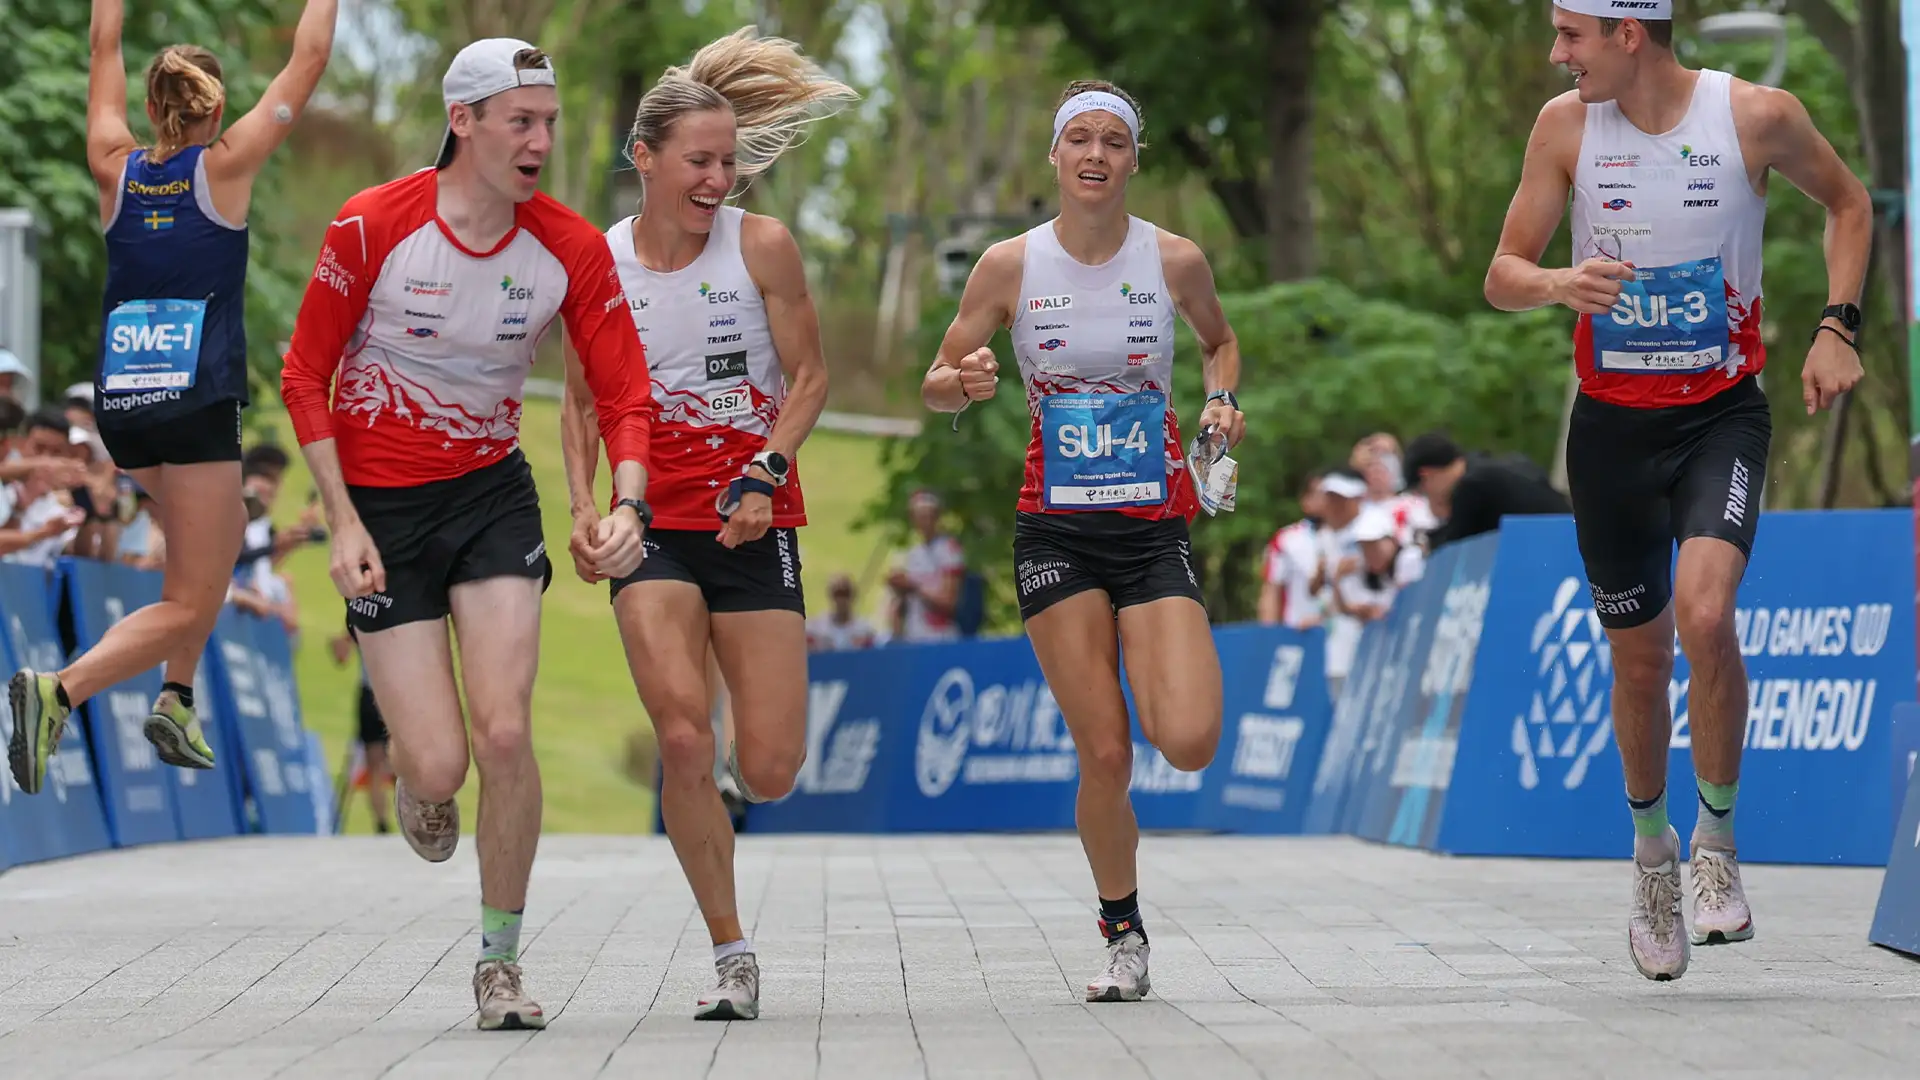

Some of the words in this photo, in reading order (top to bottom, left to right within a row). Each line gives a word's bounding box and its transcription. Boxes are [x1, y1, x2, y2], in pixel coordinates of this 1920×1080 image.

[1611, 0, 1658, 9] TRIMTEX
[1689, 155, 1721, 167] EGK
[127, 179, 190, 195] SWEDEN
[1687, 182, 1714, 191] KPMG
[1683, 199, 1720, 208] TRIMTEX
[508, 287, 534, 300] EGK
[708, 291, 740, 304] EGK
[1129, 292, 1157, 305] EGK
[1029, 296, 1071, 311] INALP
[1611, 290, 1709, 328] SUI-3
[709, 318, 736, 328] KPMG
[1129, 320, 1153, 328] KPMG
[111, 323, 194, 353] SWE-1
[707, 333, 742, 344] TRIMTEX
[1127, 336, 1158, 344] TRIMTEX
[709, 358, 729, 373] OX
[712, 396, 738, 410] GSI
[1058, 421, 1148, 458] SUI-4
[1724, 457, 1749, 527] TRIMTEX
[777, 529, 796, 588] TRIMTEX
[1595, 598, 1641, 615] eam
[1768, 605, 1851, 657] GAMES
[1742, 678, 1877, 751] HENGDU
